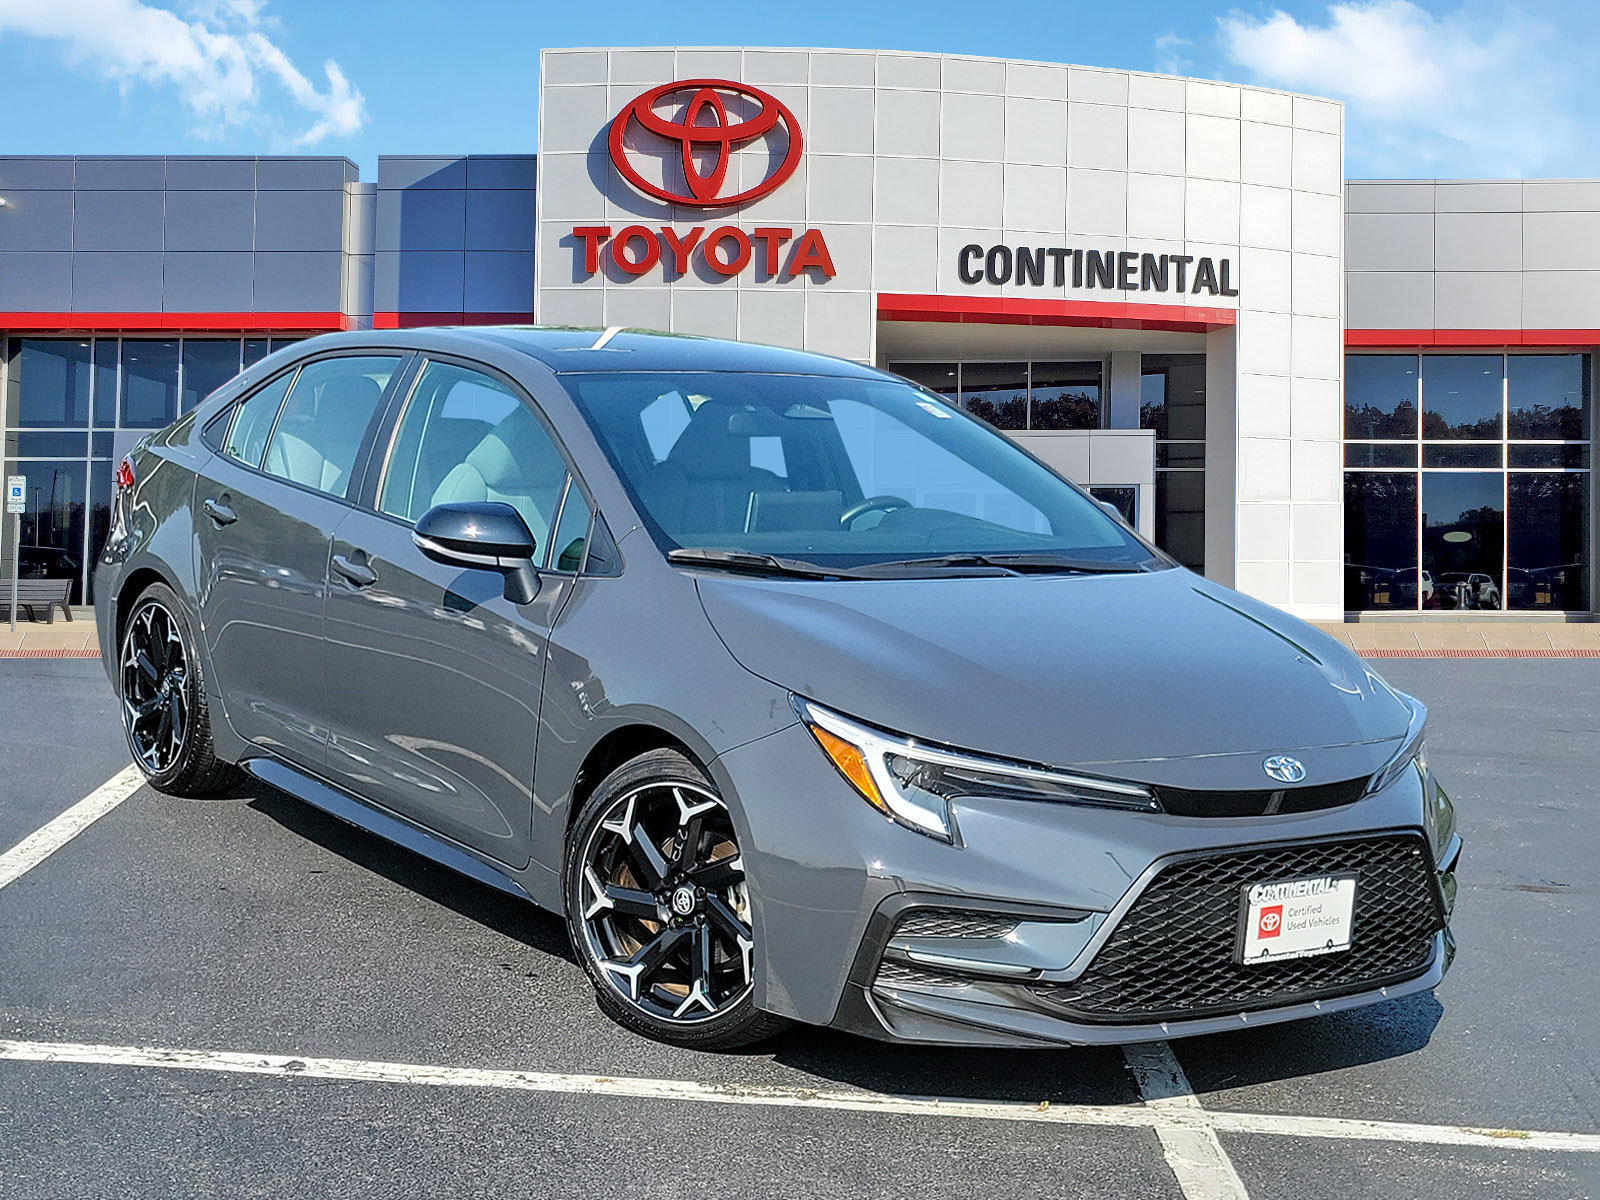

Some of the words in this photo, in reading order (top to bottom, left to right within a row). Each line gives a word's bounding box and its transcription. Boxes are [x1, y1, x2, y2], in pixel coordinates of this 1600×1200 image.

[573, 225, 837, 277] TOYOTA
[958, 244, 1239, 297] CONTINENTAL
[1249, 877, 1332, 905] CONTINENTAL
[1287, 920, 1308, 931] Used
[1309, 915, 1341, 929] Vehicles
[1288, 904, 1323, 918] Certified
